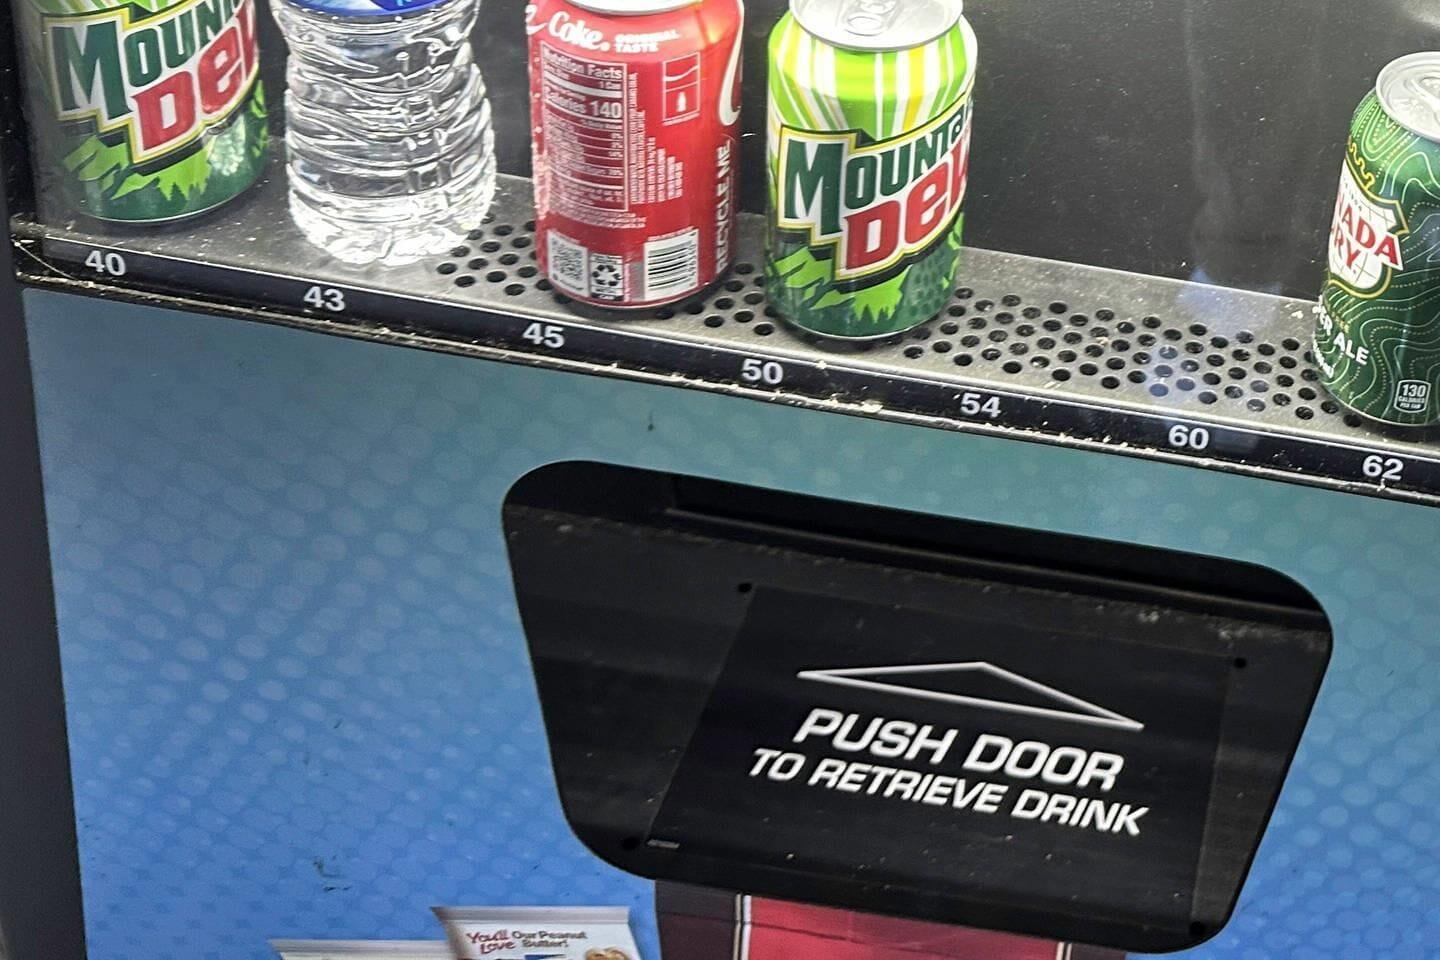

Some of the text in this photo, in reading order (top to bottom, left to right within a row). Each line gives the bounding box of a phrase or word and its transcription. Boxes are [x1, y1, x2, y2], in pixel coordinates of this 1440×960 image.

[588, 65, 623, 80] Facts
[590, 101, 622, 119] 140
[716, 140, 731, 275] RECYCLE ME
[85, 249, 127, 277] 40
[303, 285, 346, 312] 43
[523, 322, 565, 349] 45
[1333, 332, 1370, 365] ALE
[741, 359, 784, 385] 50
[1402, 384, 1426, 397] 130
[961, 393, 1001, 419] 54
[1168, 425, 1209, 449] 60
[1362, 455, 1404, 481] 62
[793, 708, 1125, 792] PUSH DOOR
[749, 748, 1150, 837] TO RETRIEVE DRINK
[480, 941, 515, 954] Love
